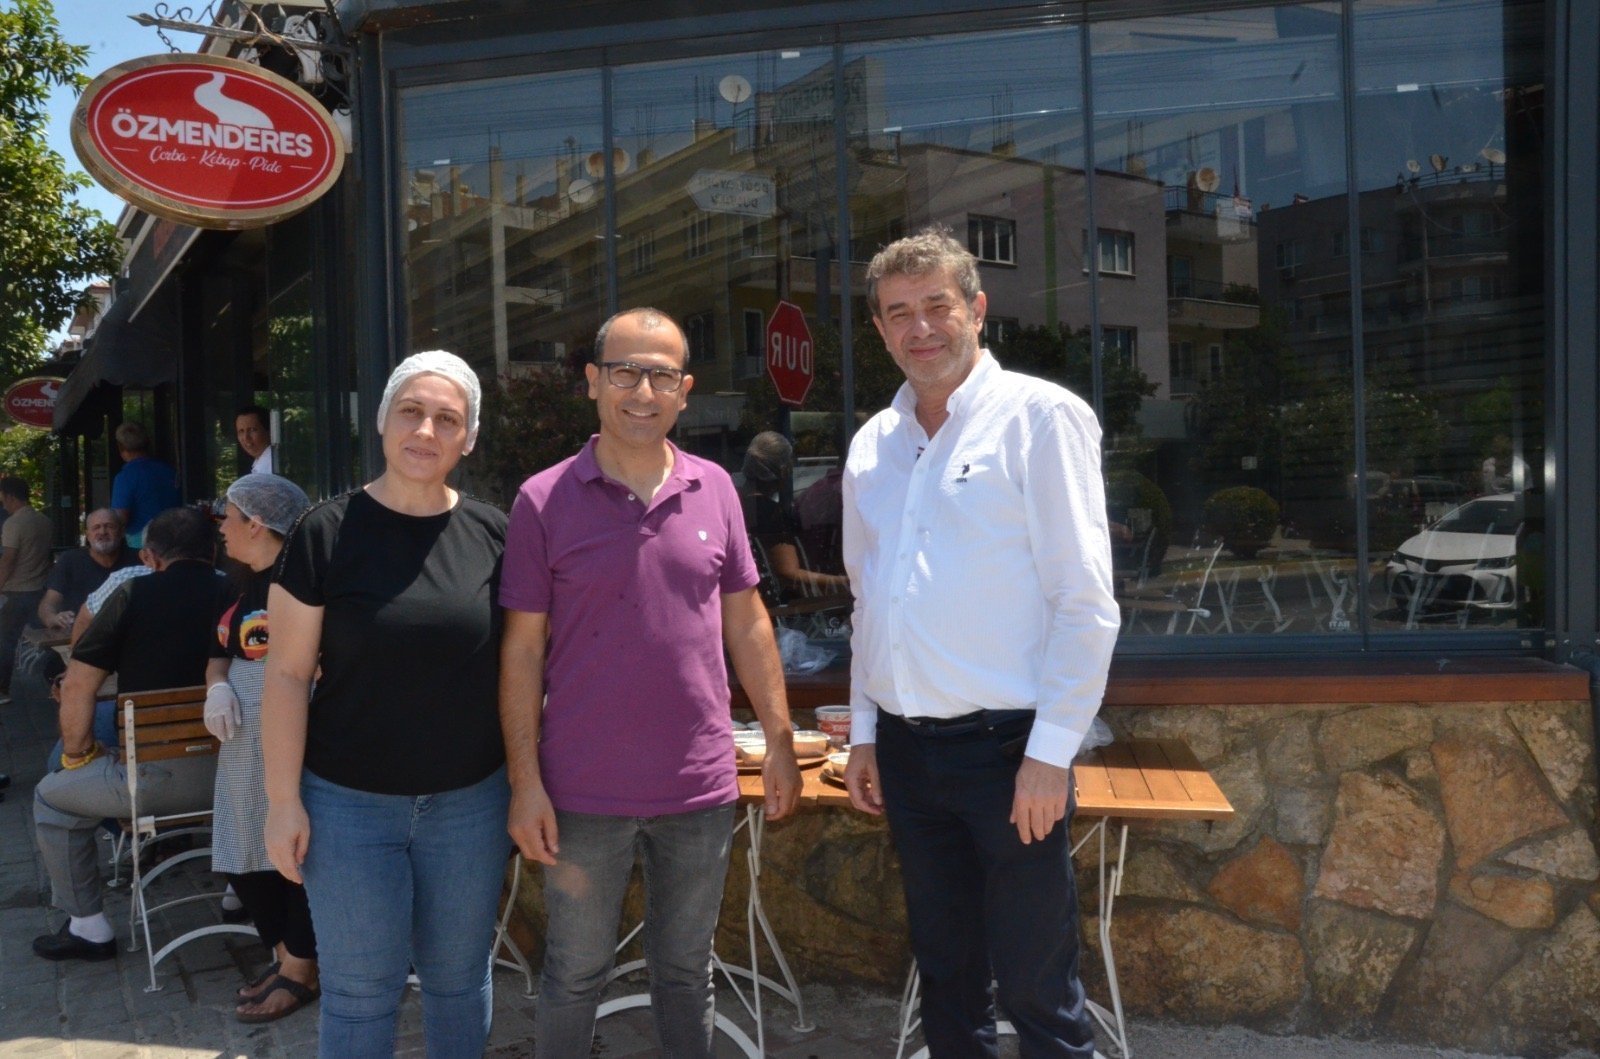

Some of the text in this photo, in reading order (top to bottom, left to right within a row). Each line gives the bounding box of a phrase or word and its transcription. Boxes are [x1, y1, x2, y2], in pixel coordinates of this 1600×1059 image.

[111, 107, 313, 158] ÖZMENDERES
[199, 150, 240, 170] Kebap
[248, 156, 284, 174] Pide
